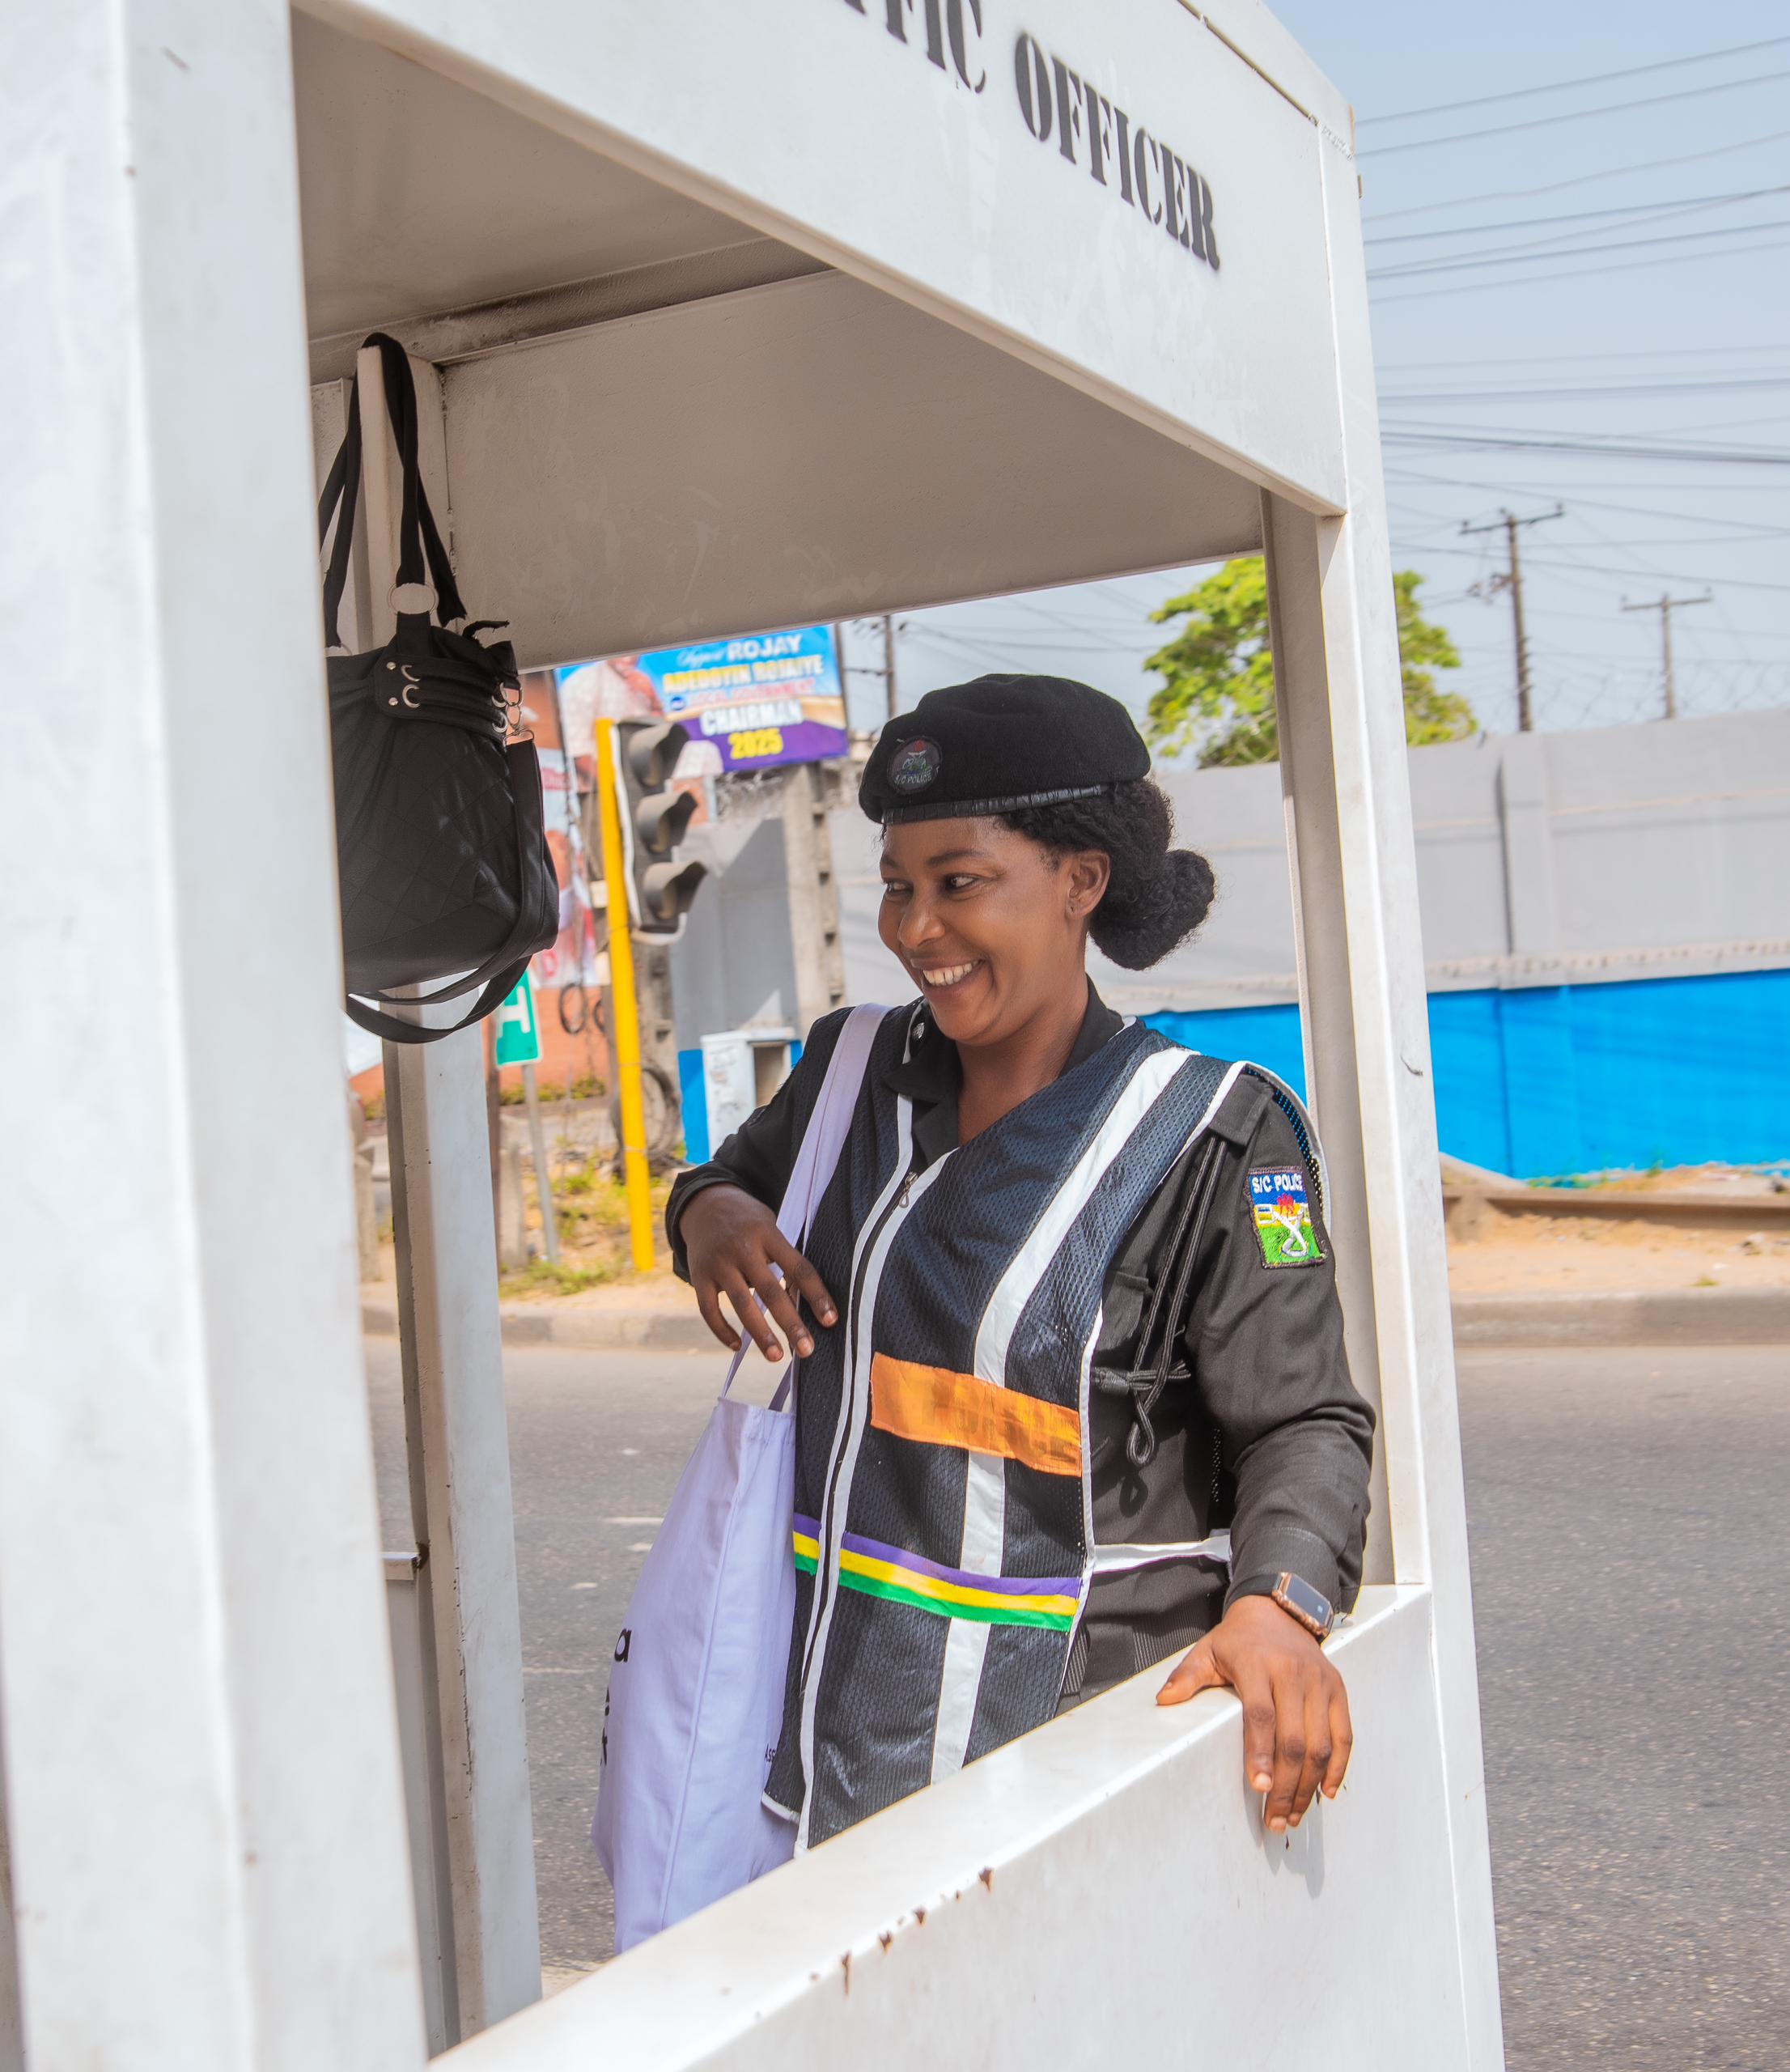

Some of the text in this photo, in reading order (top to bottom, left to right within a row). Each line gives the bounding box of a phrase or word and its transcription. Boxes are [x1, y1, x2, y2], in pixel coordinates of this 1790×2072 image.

[1014, 29, 1220, 271] OFFICER
[727, 635, 803, 662] ROJAY
[699, 698, 804, 737] CHAIRMAN
[727, 727, 783, 760] 2025
[907, 770, 932, 784] POLICE
[1251, 1175, 1273, 1194] S/C
